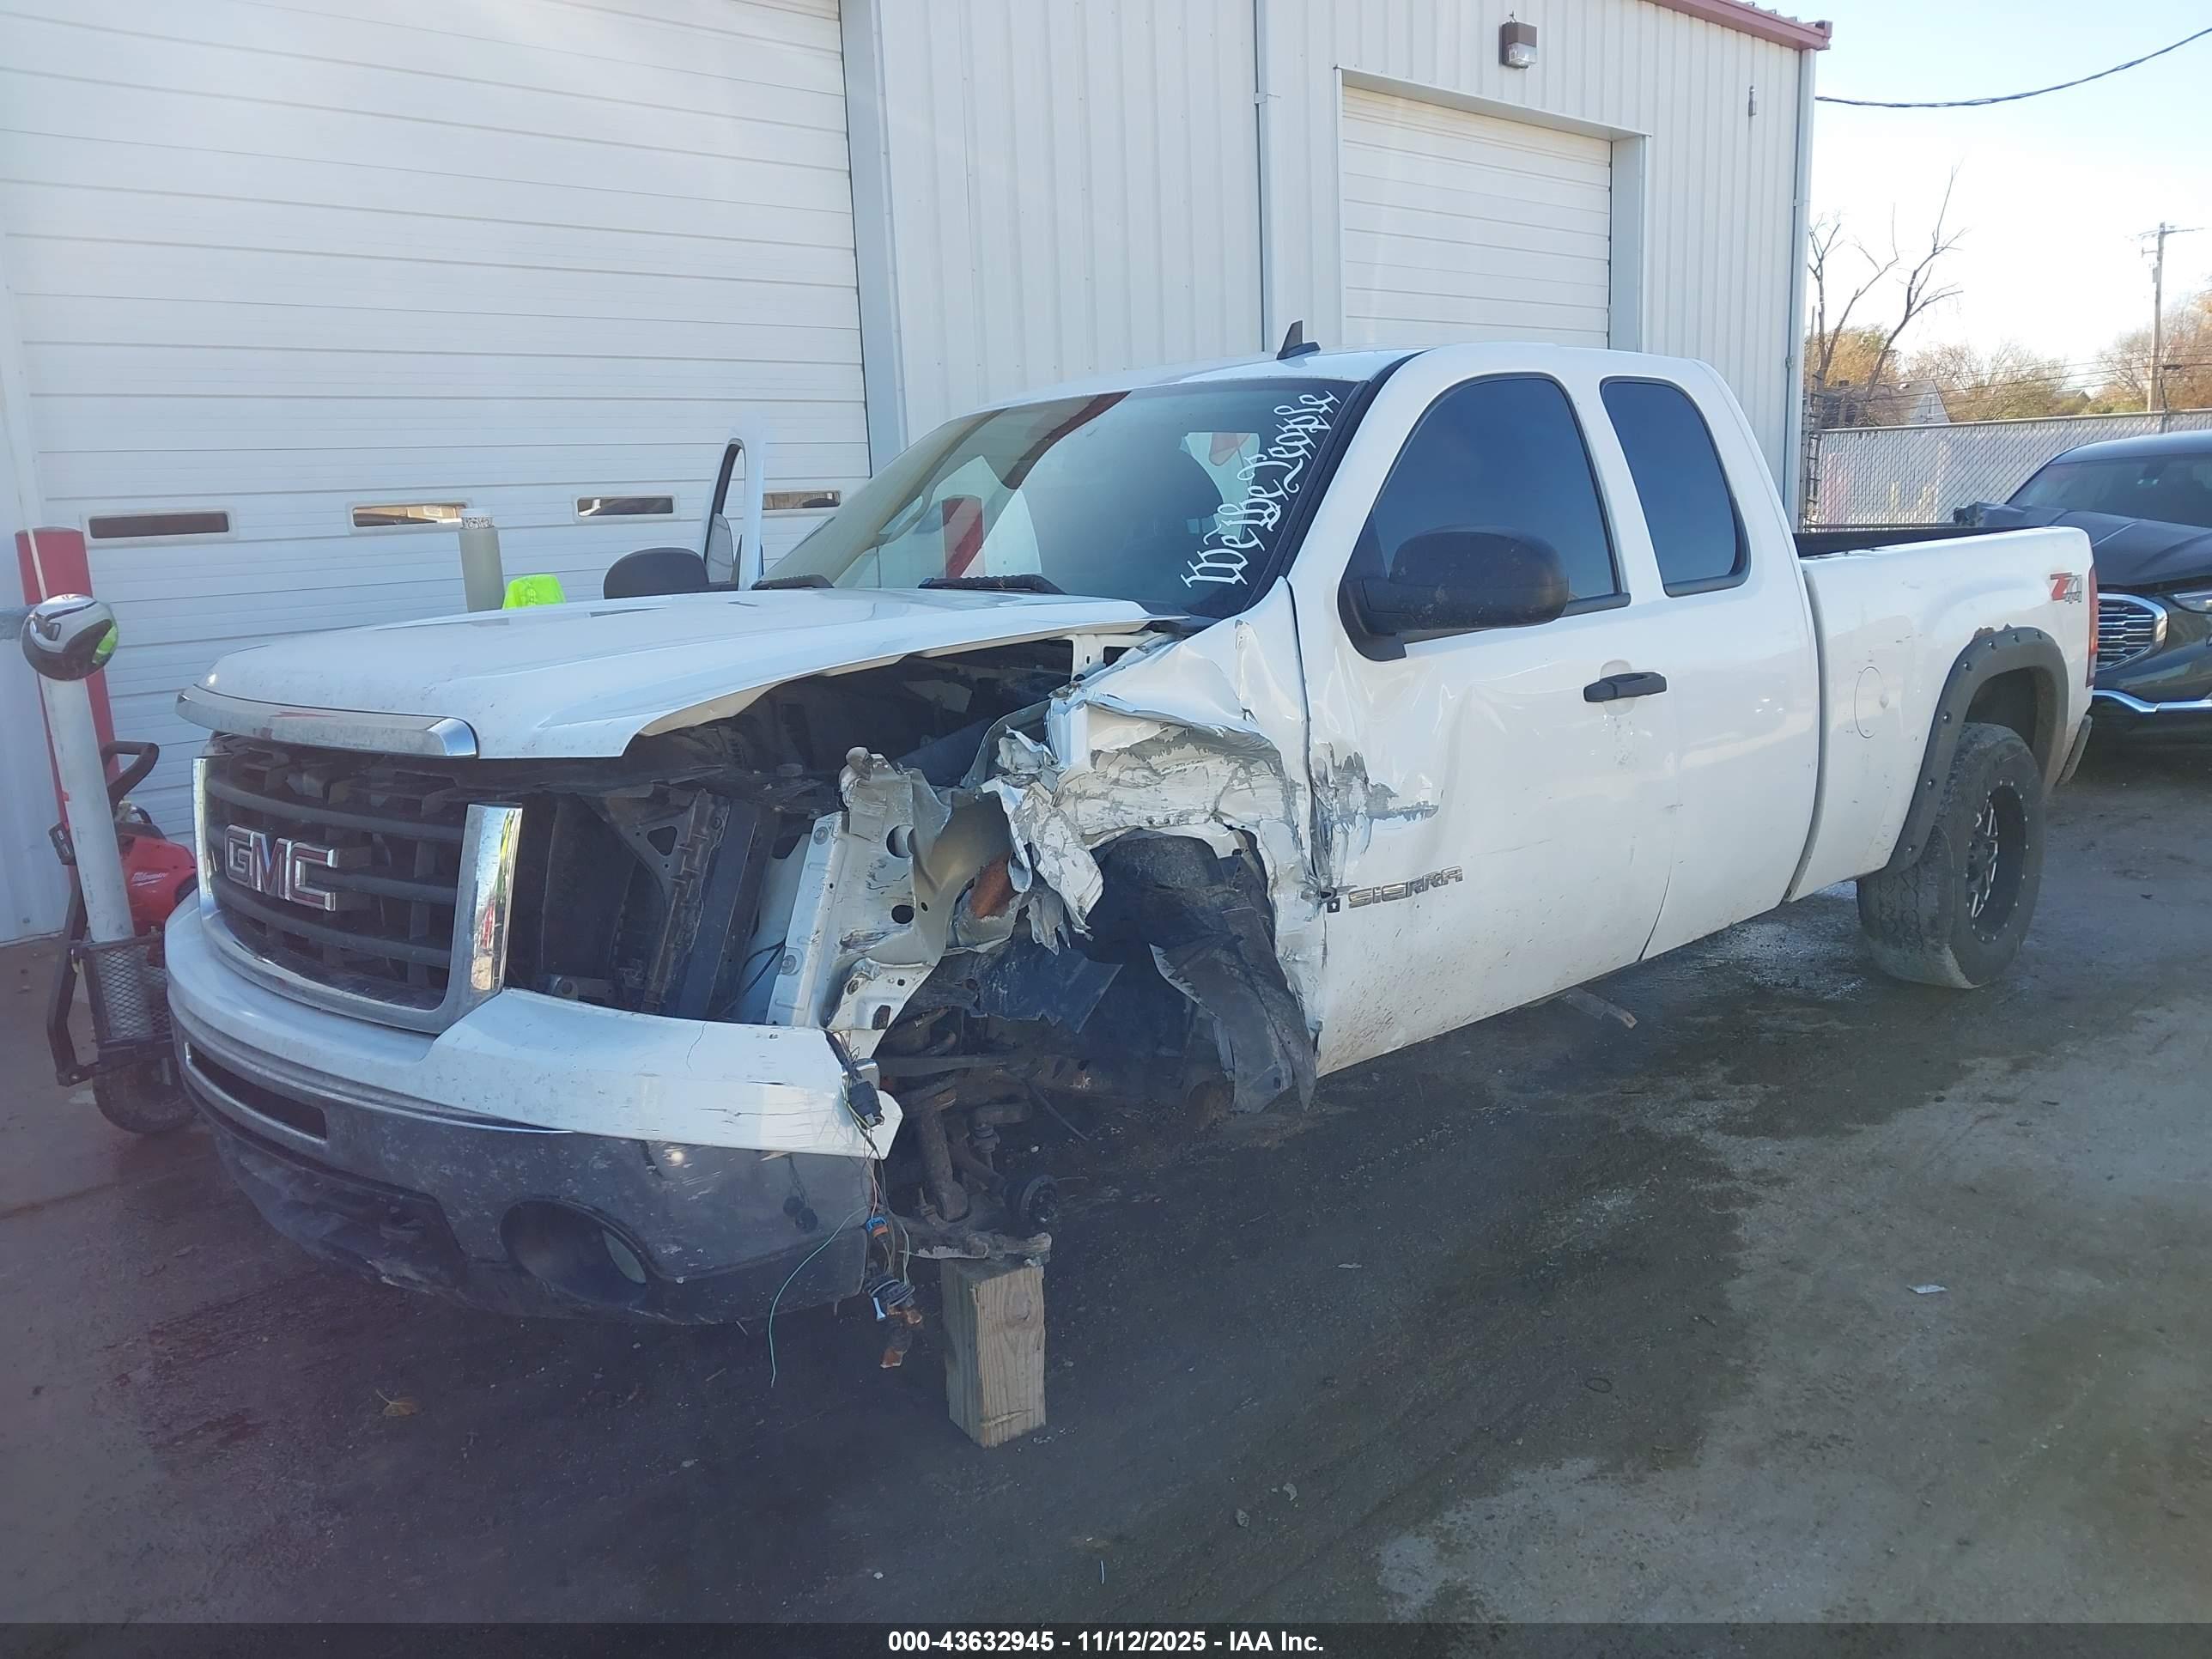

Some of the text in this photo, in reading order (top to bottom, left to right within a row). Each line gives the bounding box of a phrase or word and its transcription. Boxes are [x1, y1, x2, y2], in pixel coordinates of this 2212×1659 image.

[1237, 390, 1341, 494] People
[225, 824, 338, 911] GMC
[1348, 866, 1463, 908] SIERRA
